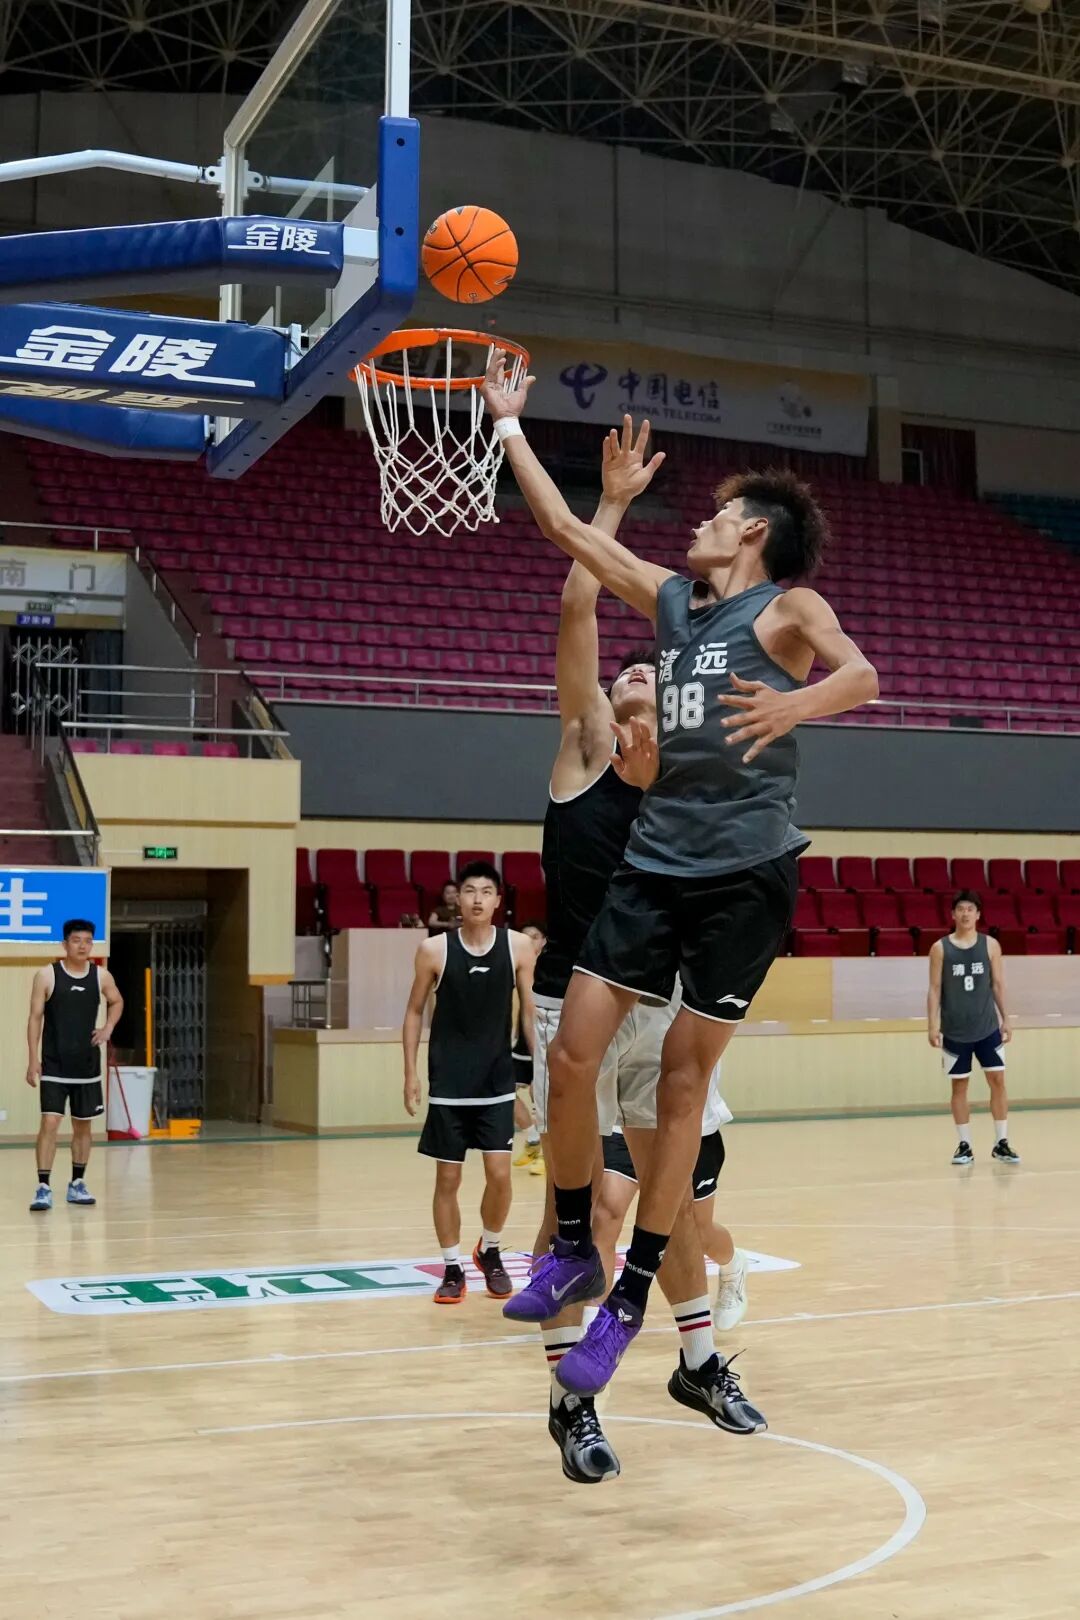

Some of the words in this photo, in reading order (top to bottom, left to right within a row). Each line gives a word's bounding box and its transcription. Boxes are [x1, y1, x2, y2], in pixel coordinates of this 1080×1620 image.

[228, 223, 330, 255] 金陵
[0, 325, 256, 388] 金陵
[618, 367, 720, 410] 中国电信
[618, 402, 660, 416] CHINA
[662, 407, 722, 424] TELECOM
[662, 681, 705, 732] 98
